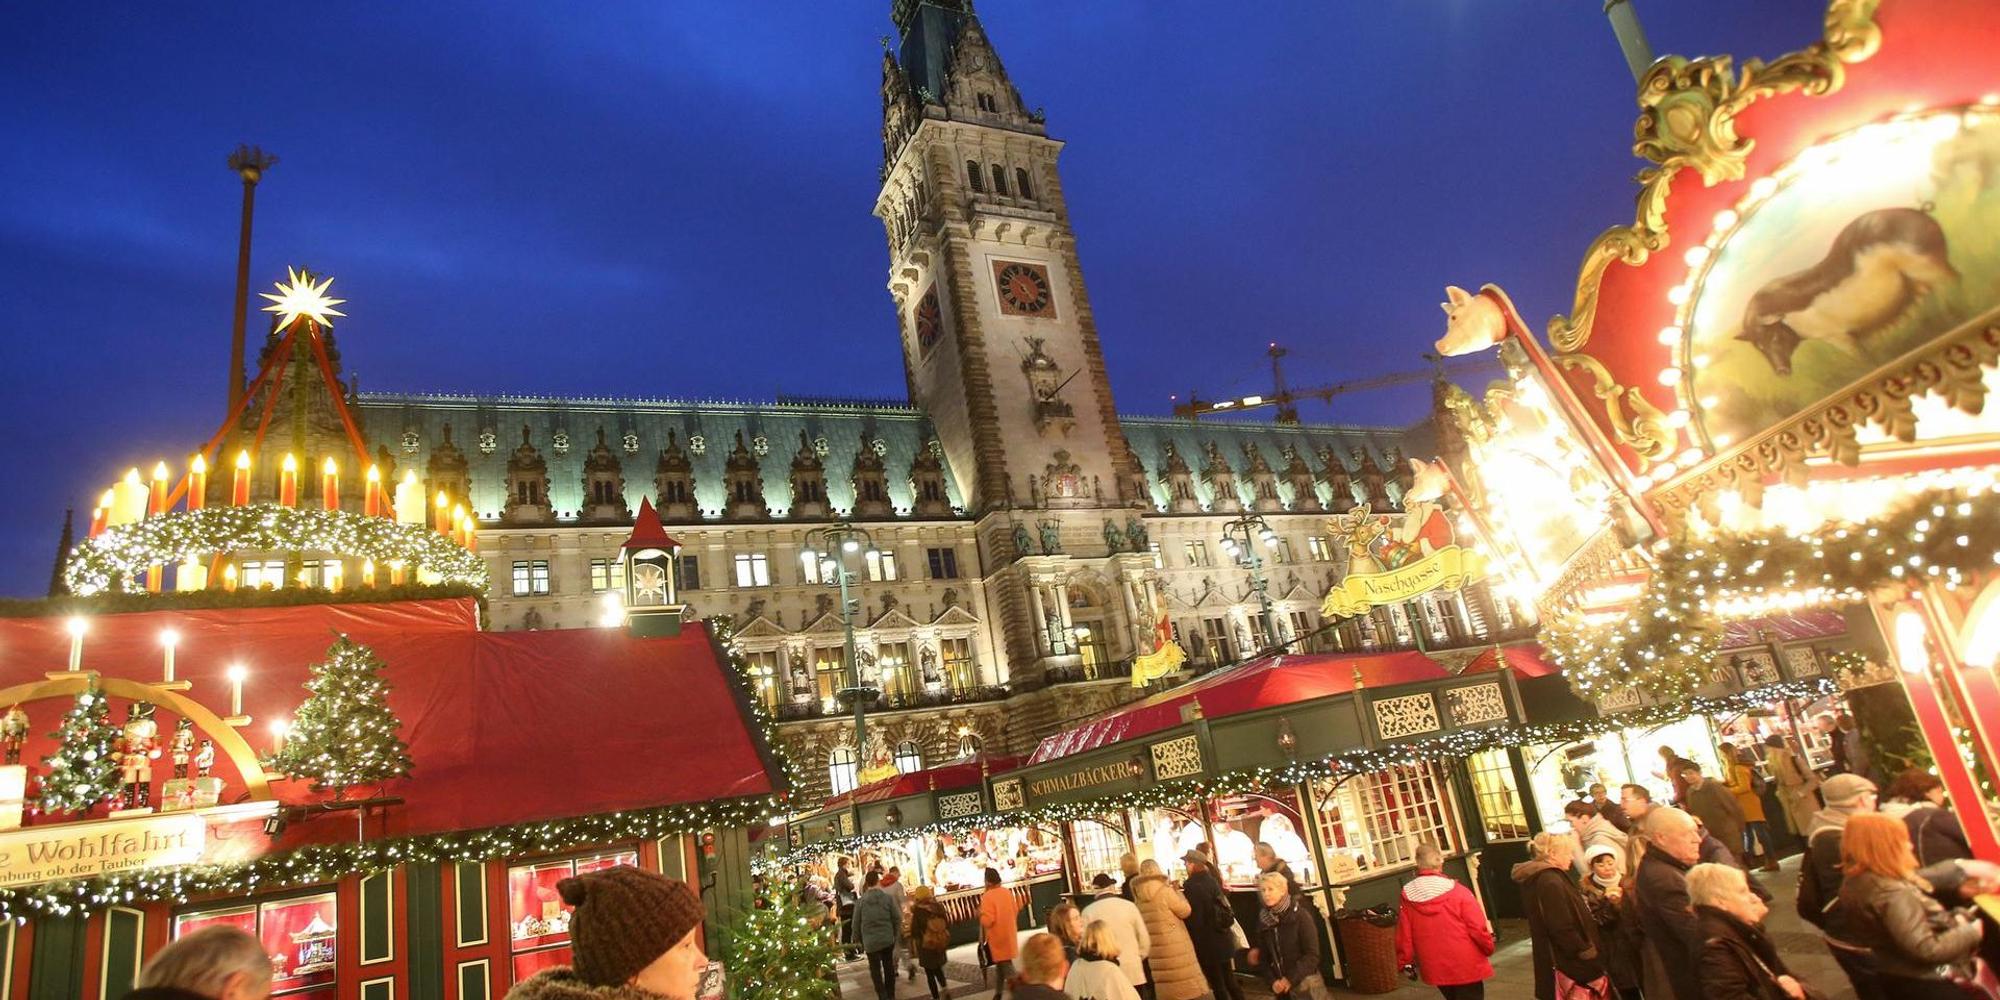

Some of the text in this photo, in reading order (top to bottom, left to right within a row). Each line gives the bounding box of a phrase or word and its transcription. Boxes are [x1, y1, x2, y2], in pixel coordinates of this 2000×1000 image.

[1031, 761, 1141, 796] SCHMALZBÄCKERE
[27, 829, 186, 864] Wohlfahrt
[46, 867, 65, 877] ob
[69, 862, 94, 875] der
[98, 857, 146, 872] Tauber
